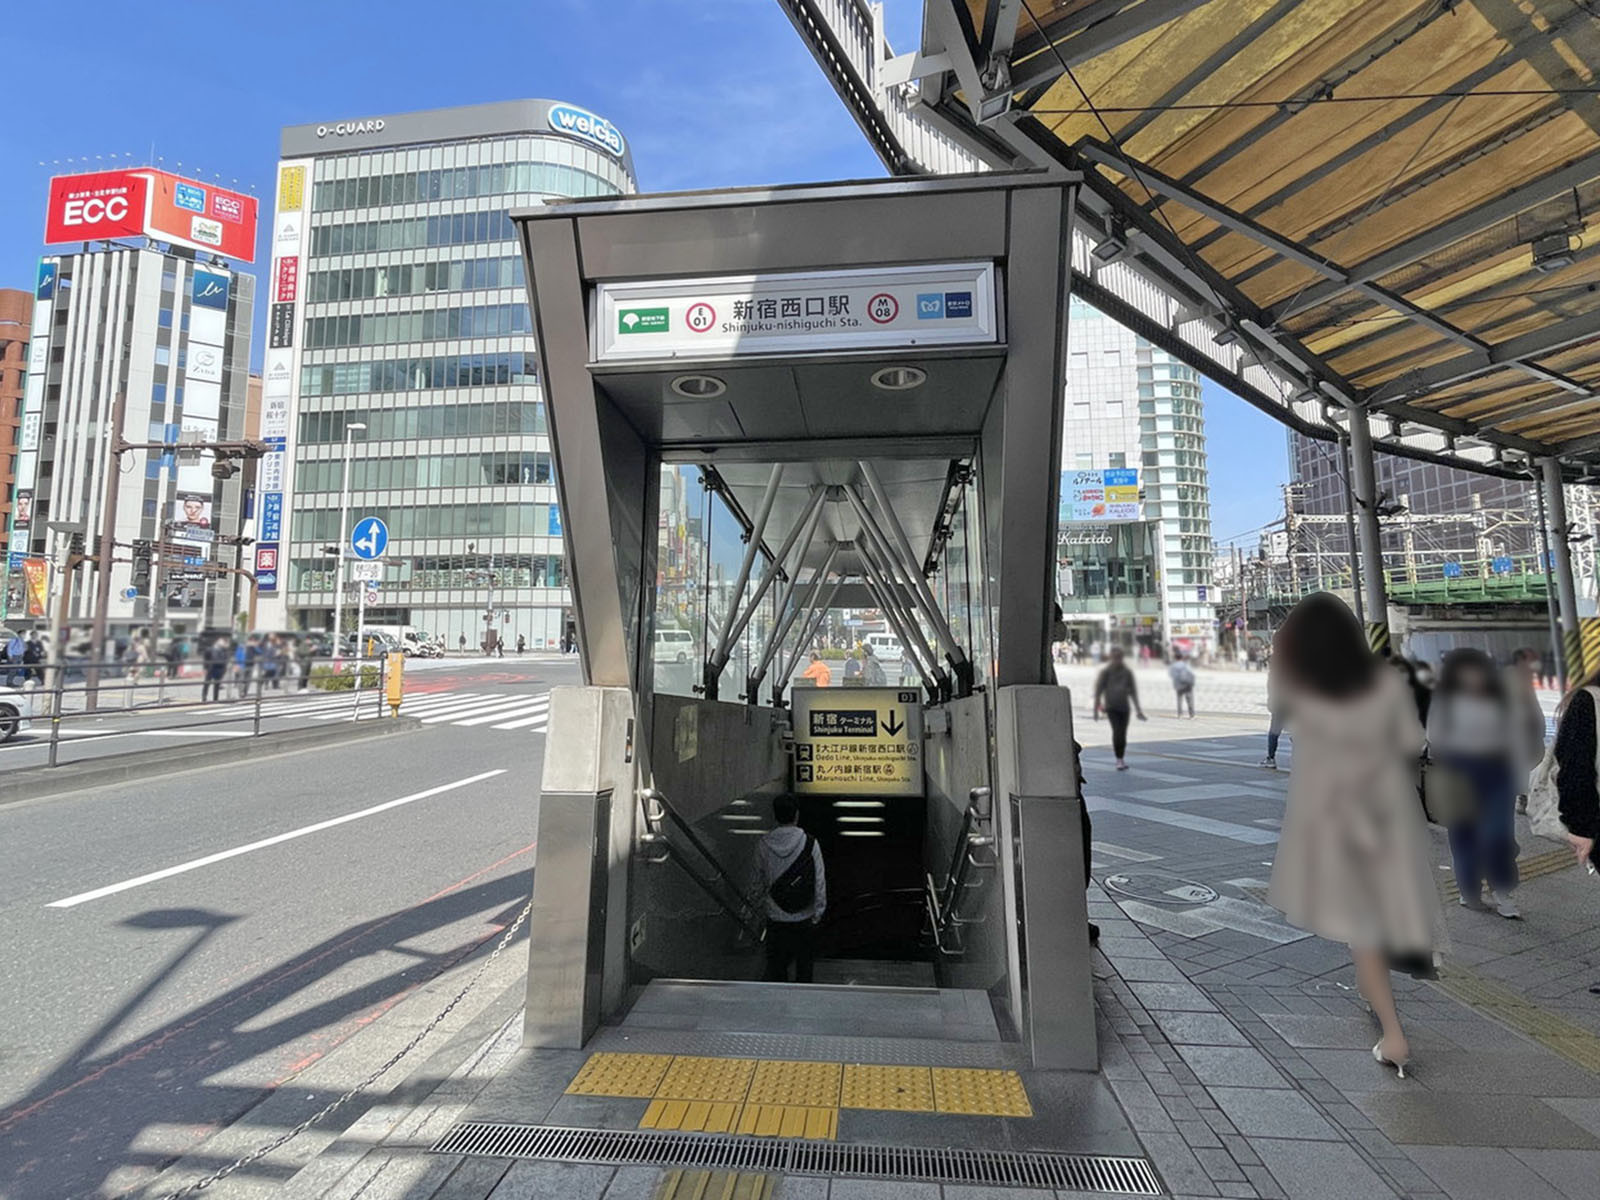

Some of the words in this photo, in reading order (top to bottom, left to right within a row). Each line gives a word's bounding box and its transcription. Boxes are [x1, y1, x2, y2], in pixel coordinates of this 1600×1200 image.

[317, 120, 384, 138] O-GUARD
[215, 196, 240, 209] ECC
[64, 196, 128, 226] ECC
[733, 295, 850, 321] 新宿西口駅
[878, 299, 888, 307] M
[698, 308, 704, 316] E
[875, 308, 891, 317] 08
[694, 317, 707, 327] 01
[722, 318, 836, 334] Shinjuku-nishiguchi
[840, 317, 862, 327] Sta.
[265, 454, 273, 489] クリニック
[260, 552, 275, 568] 薬
[813, 713, 838, 725] 新宿
[840, 716, 873, 725] ターミナル
[814, 726, 842, 735] Shinjuku
[816, 765, 882, 774] 丸ノ内線新宿駅
